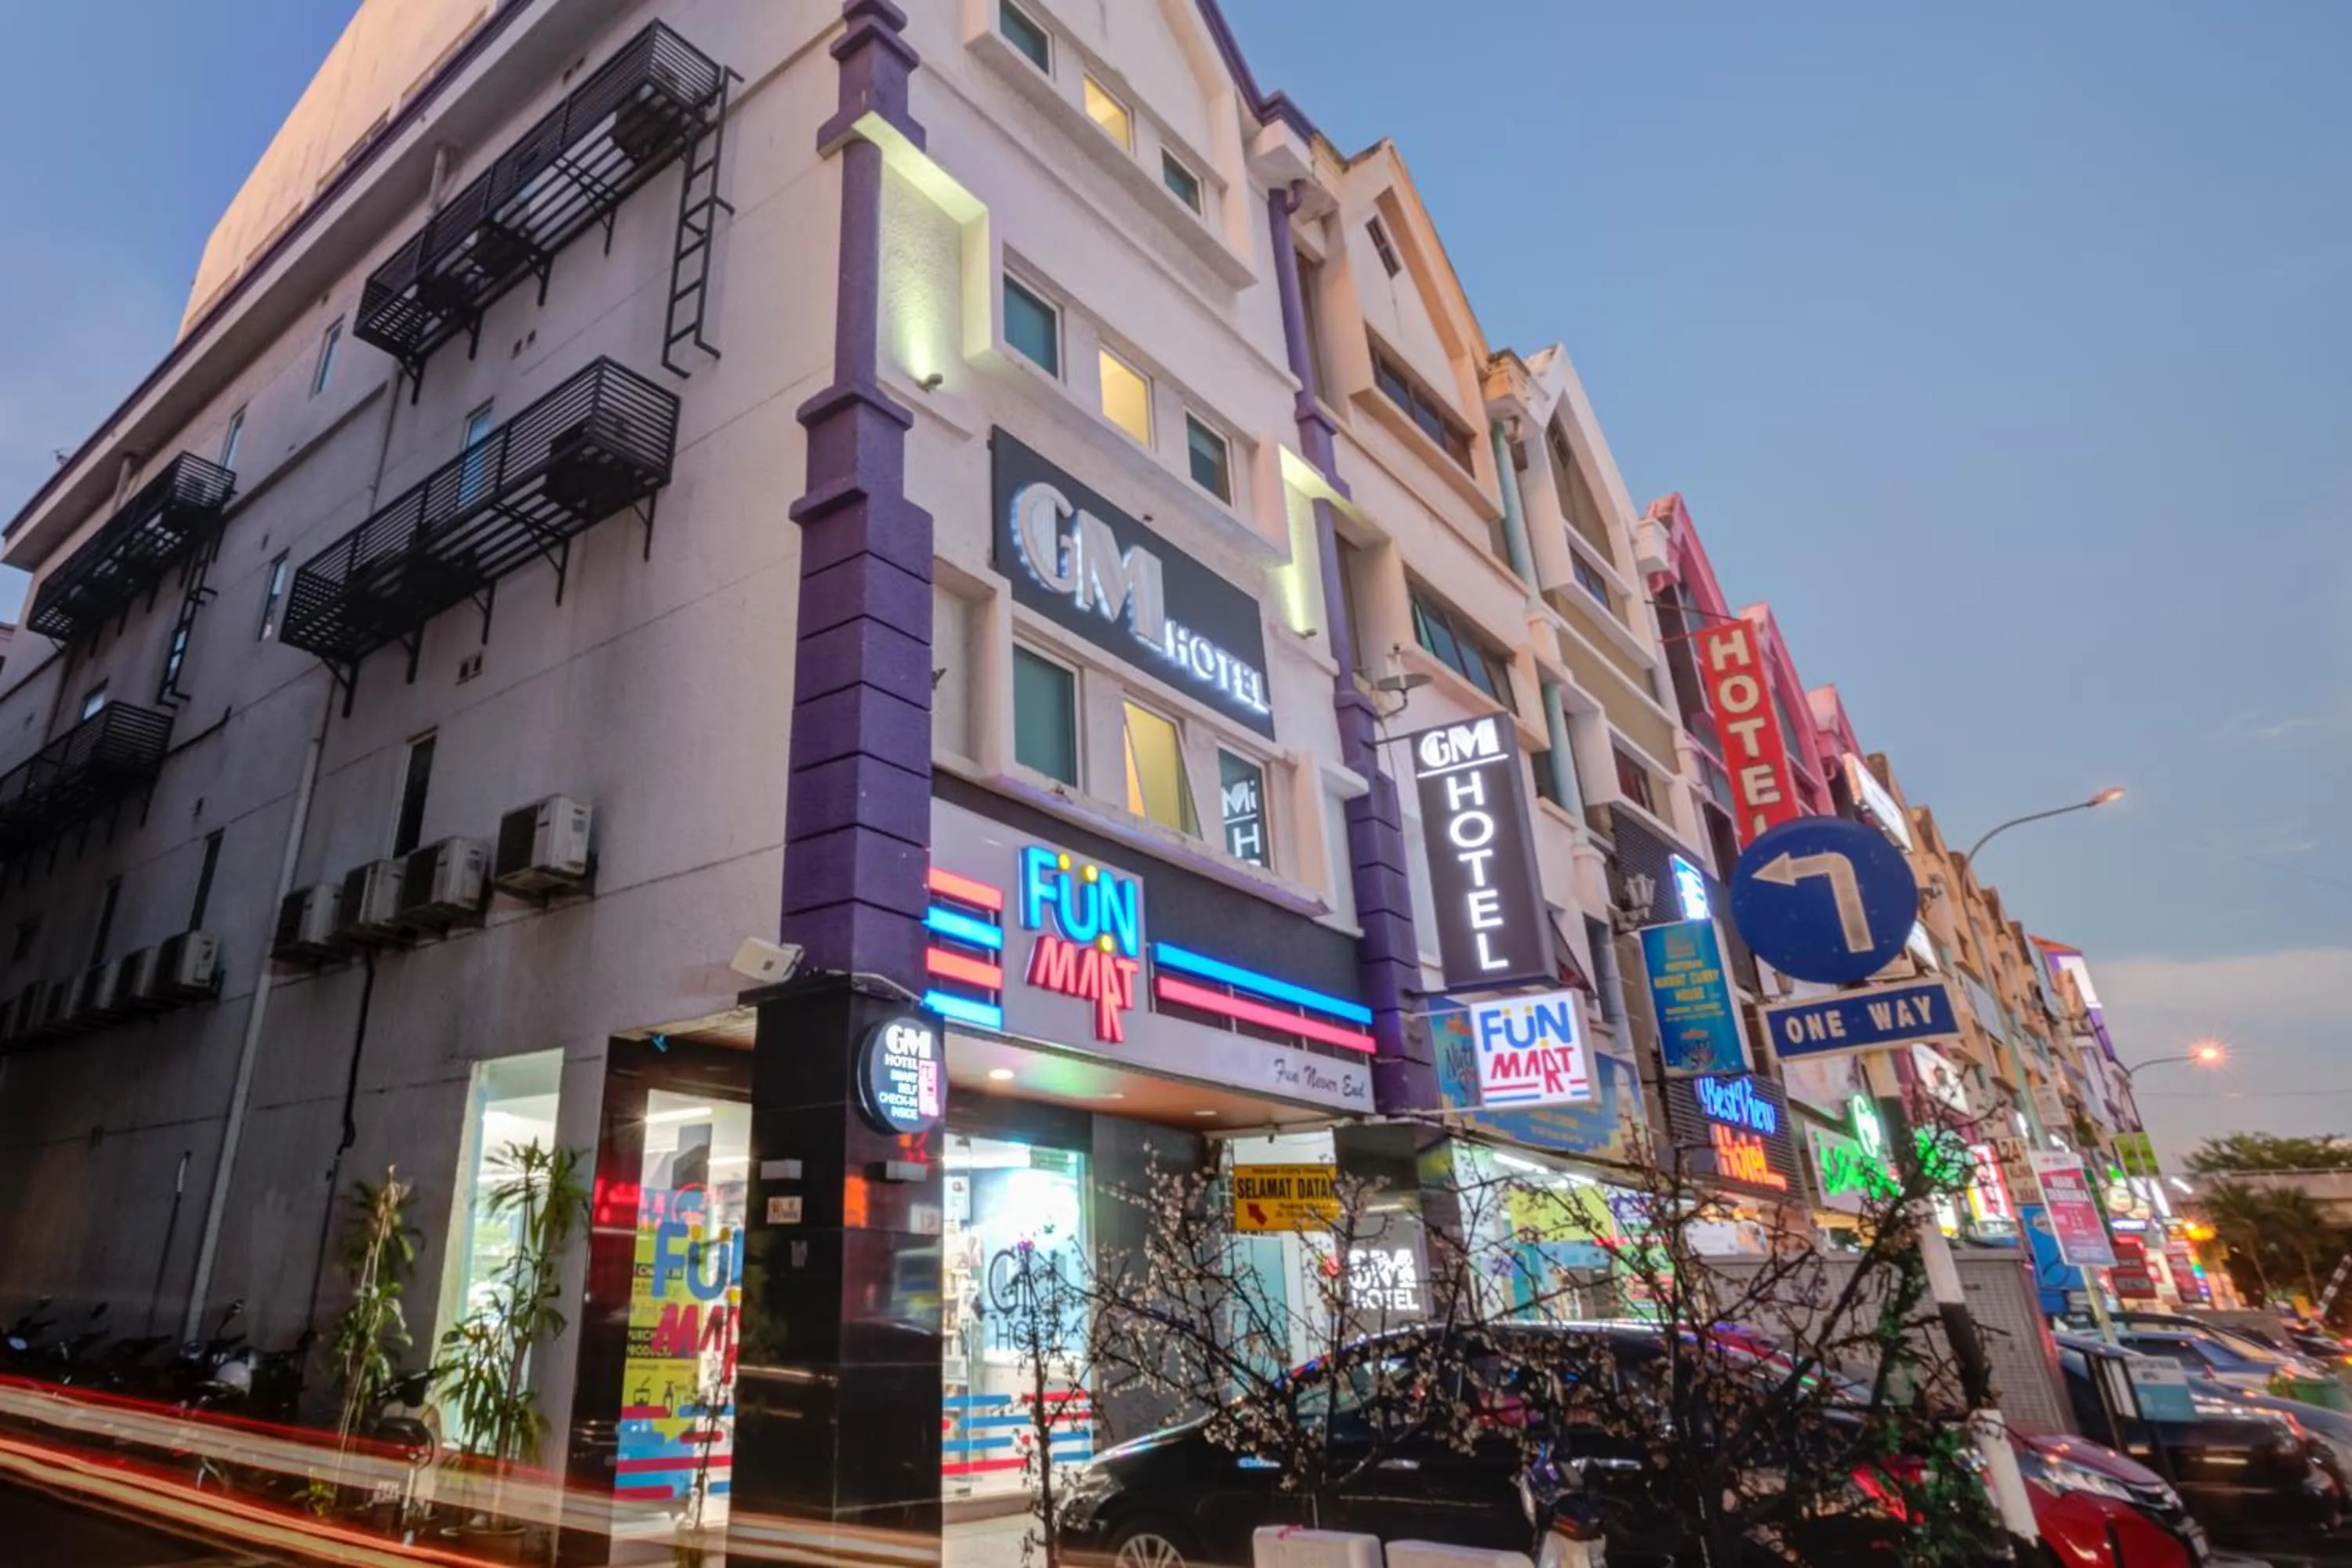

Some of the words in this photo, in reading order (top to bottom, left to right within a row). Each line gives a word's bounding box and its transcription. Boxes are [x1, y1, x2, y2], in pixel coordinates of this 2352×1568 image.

[1011, 481, 1167, 652] GM
[1163, 618, 1271, 714] HOTEL
[1420, 717, 1499, 768] GM
[1446, 770, 1509, 970] HOTEL
[885, 1025, 931, 1058] GM
[1785, 1010, 1846, 1044] ONE
[1867, 994, 1932, 1031] WAY
[884, 1053, 918, 1069] HOTEL
[1274, 1058, 1299, 1083] Fun
[1303, 1065, 1337, 1092] Never
[1342, 1074, 1365, 1098] End
[1237, 1178, 1293, 1200] SELAMAT
